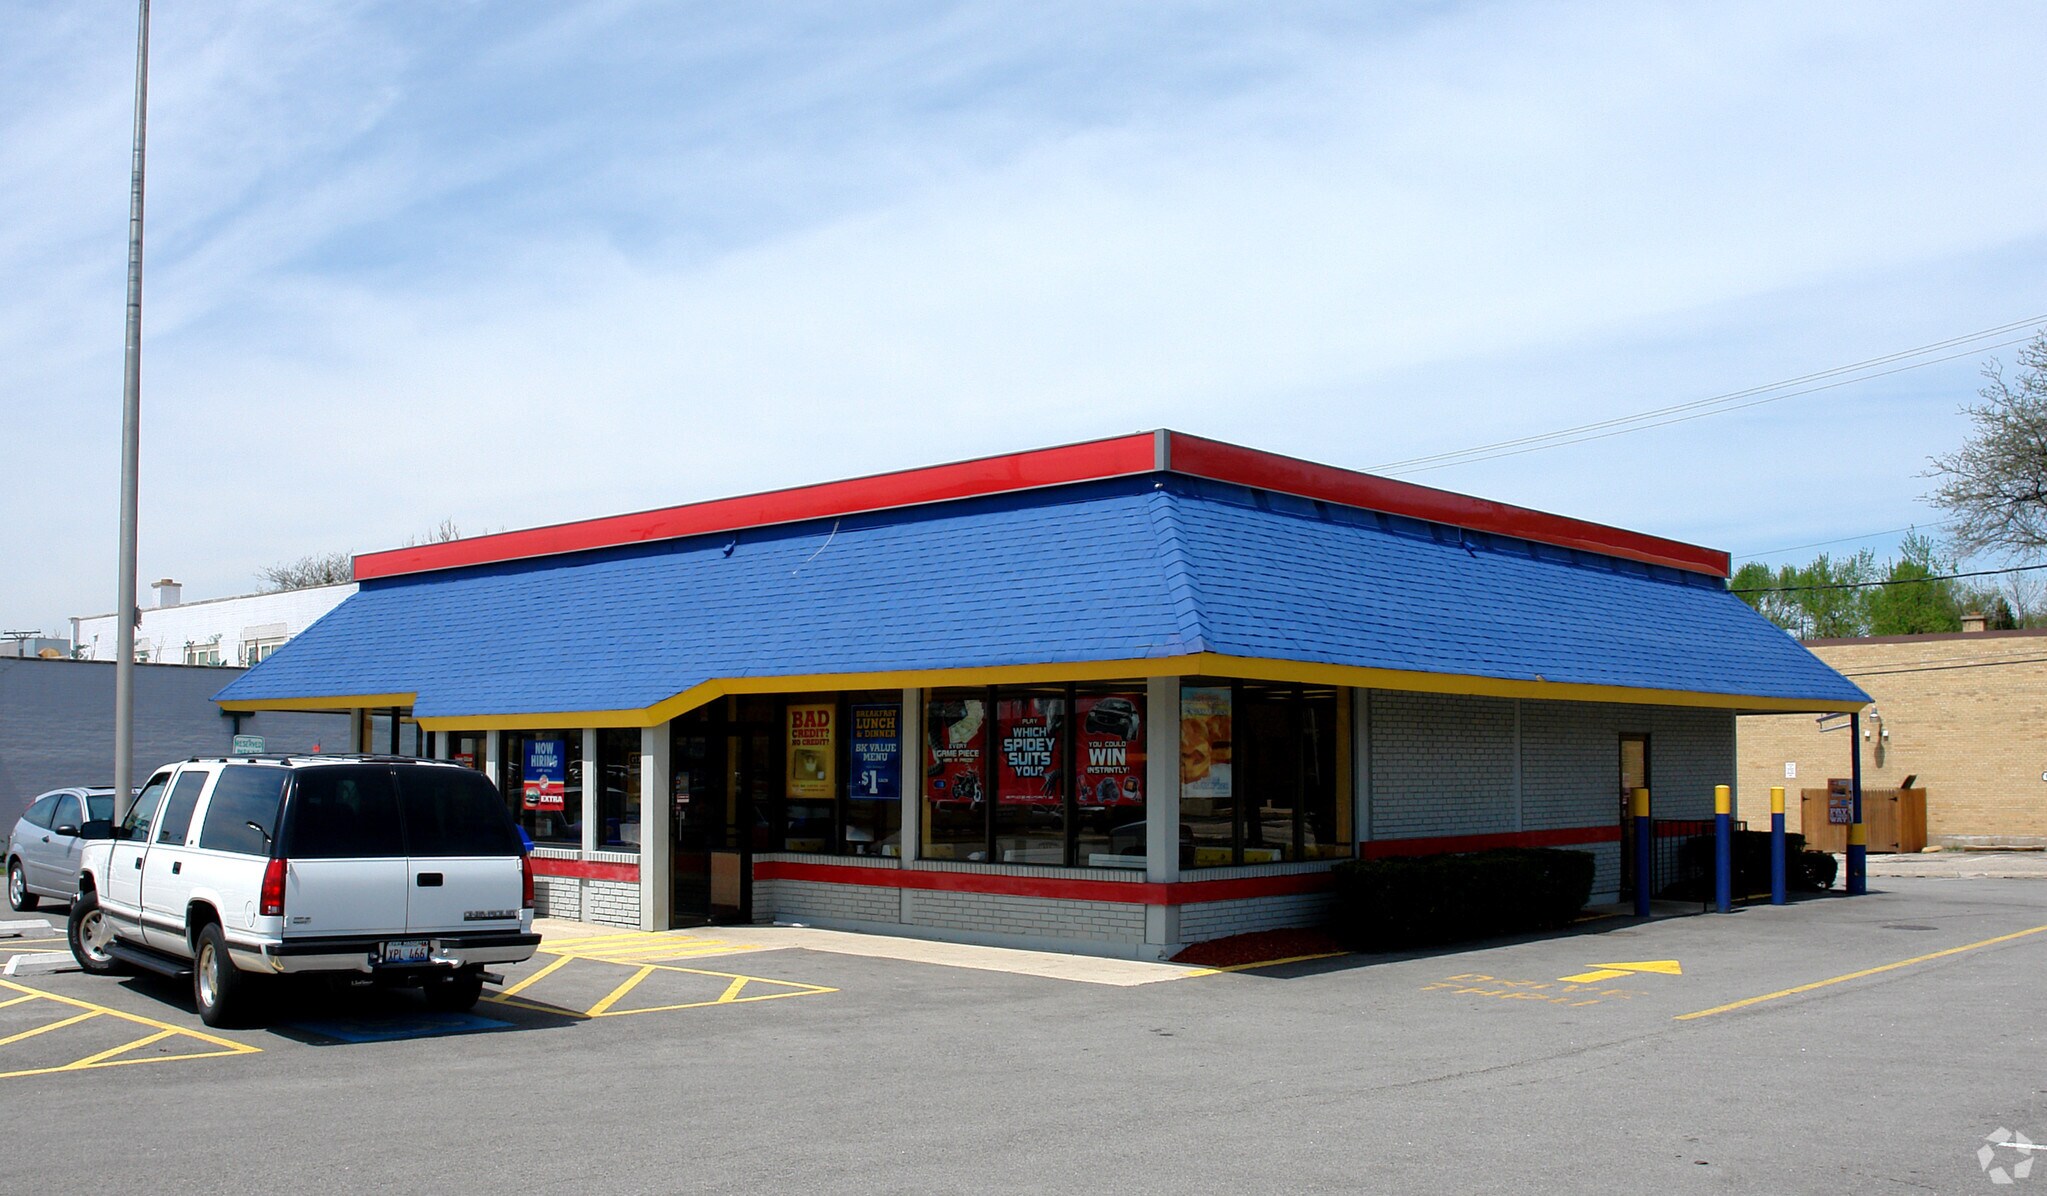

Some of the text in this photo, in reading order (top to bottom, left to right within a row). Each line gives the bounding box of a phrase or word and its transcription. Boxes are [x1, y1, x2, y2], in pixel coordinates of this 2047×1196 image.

[792, 710, 830, 728] BAD
[856, 710, 897, 718] BREAKFAST
[856, 718, 896, 729] LUNCH
[792, 729, 830, 738] CREDIT?
[864, 730, 896, 738] DINNER
[1012, 727, 1047, 737] WHICH
[535, 742, 554, 754] NOW
[855, 743, 897, 752] BK VALUE
[1003, 737, 1056, 752] SPIDEY
[863, 752, 888, 762] MENU
[937, 749, 980, 757] GAME PIECE
[1088, 748, 1126, 766] WIN
[530, 755, 558, 768] HIRING
[1008, 752, 1051, 766] SUITS
[1015, 766, 1045, 776] YOU?
[1087, 766, 1130, 774] INSTANTLY!
[540, 795, 563, 803] EXTRA
[388, 947, 425, 960] XPL 466
